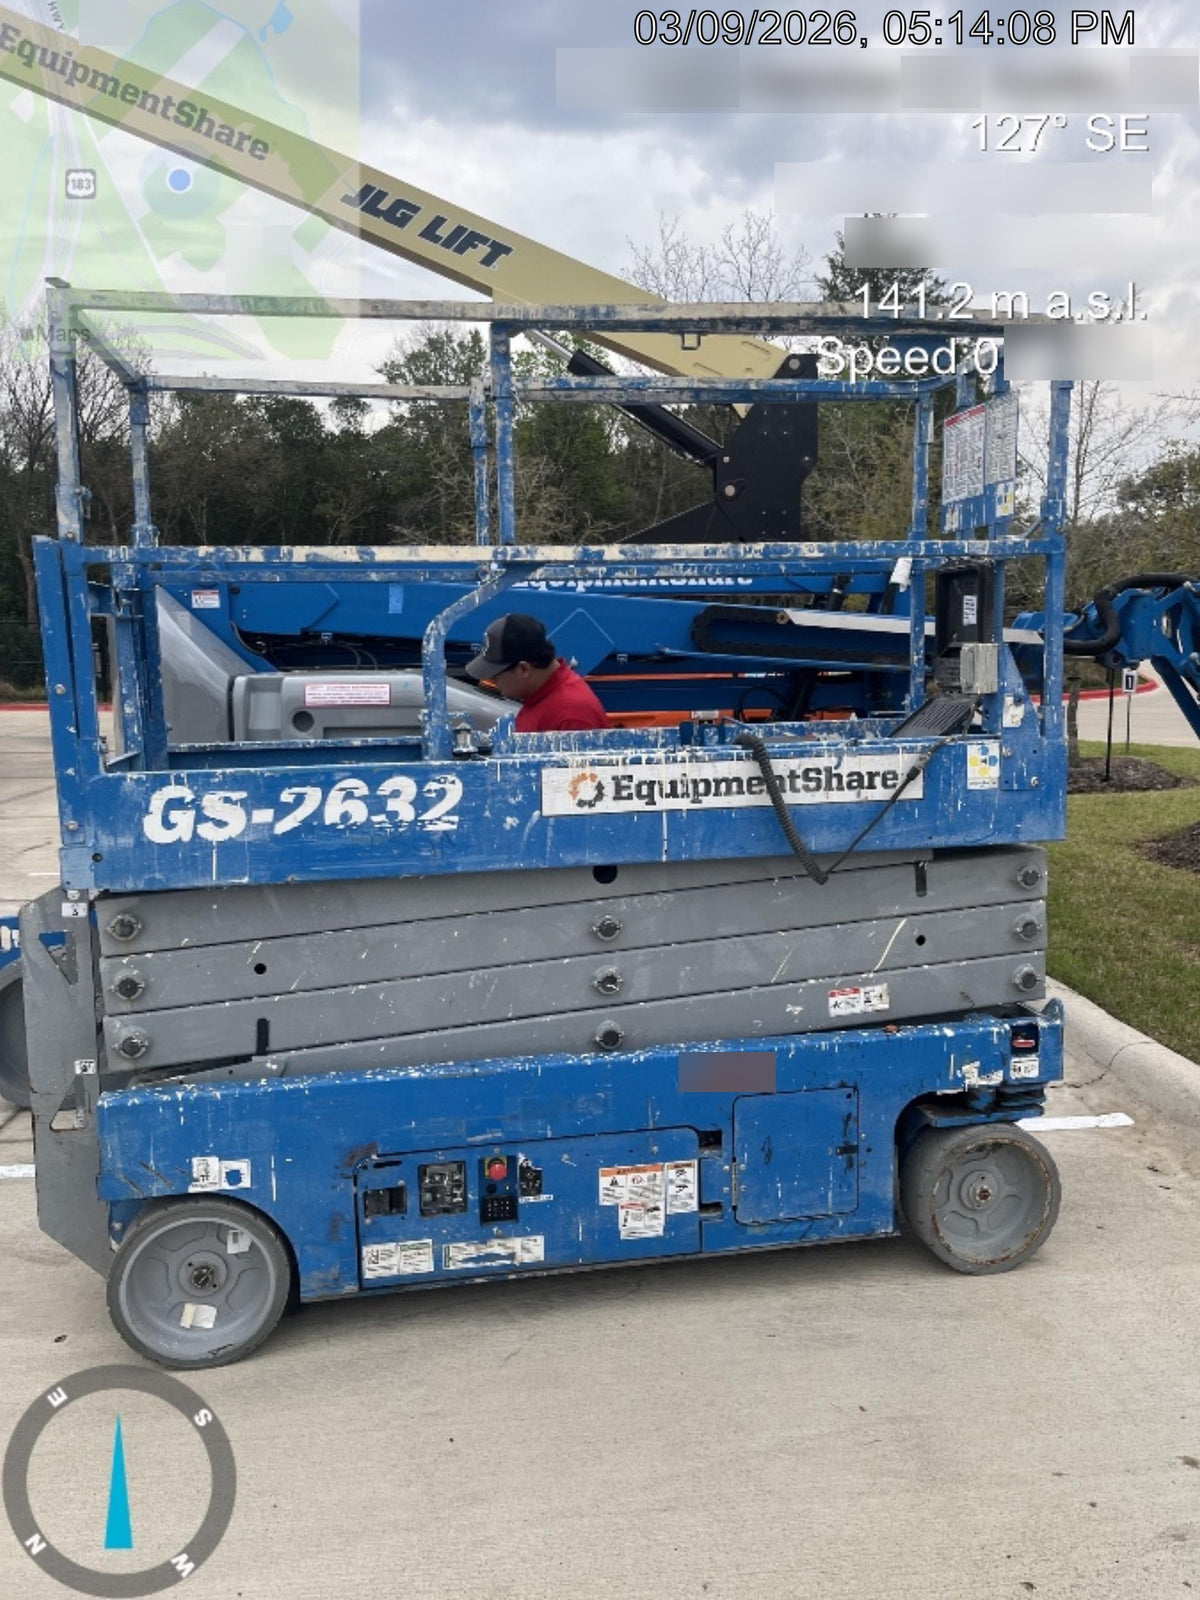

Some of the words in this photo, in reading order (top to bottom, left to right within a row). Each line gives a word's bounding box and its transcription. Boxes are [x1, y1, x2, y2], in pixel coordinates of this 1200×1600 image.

[0, 23, 269, 160] EquipmentShare
[340, 183, 422, 230] JLG
[417, 214, 514, 268] LIFT
[143, 774, 464, 844] GS-2632
